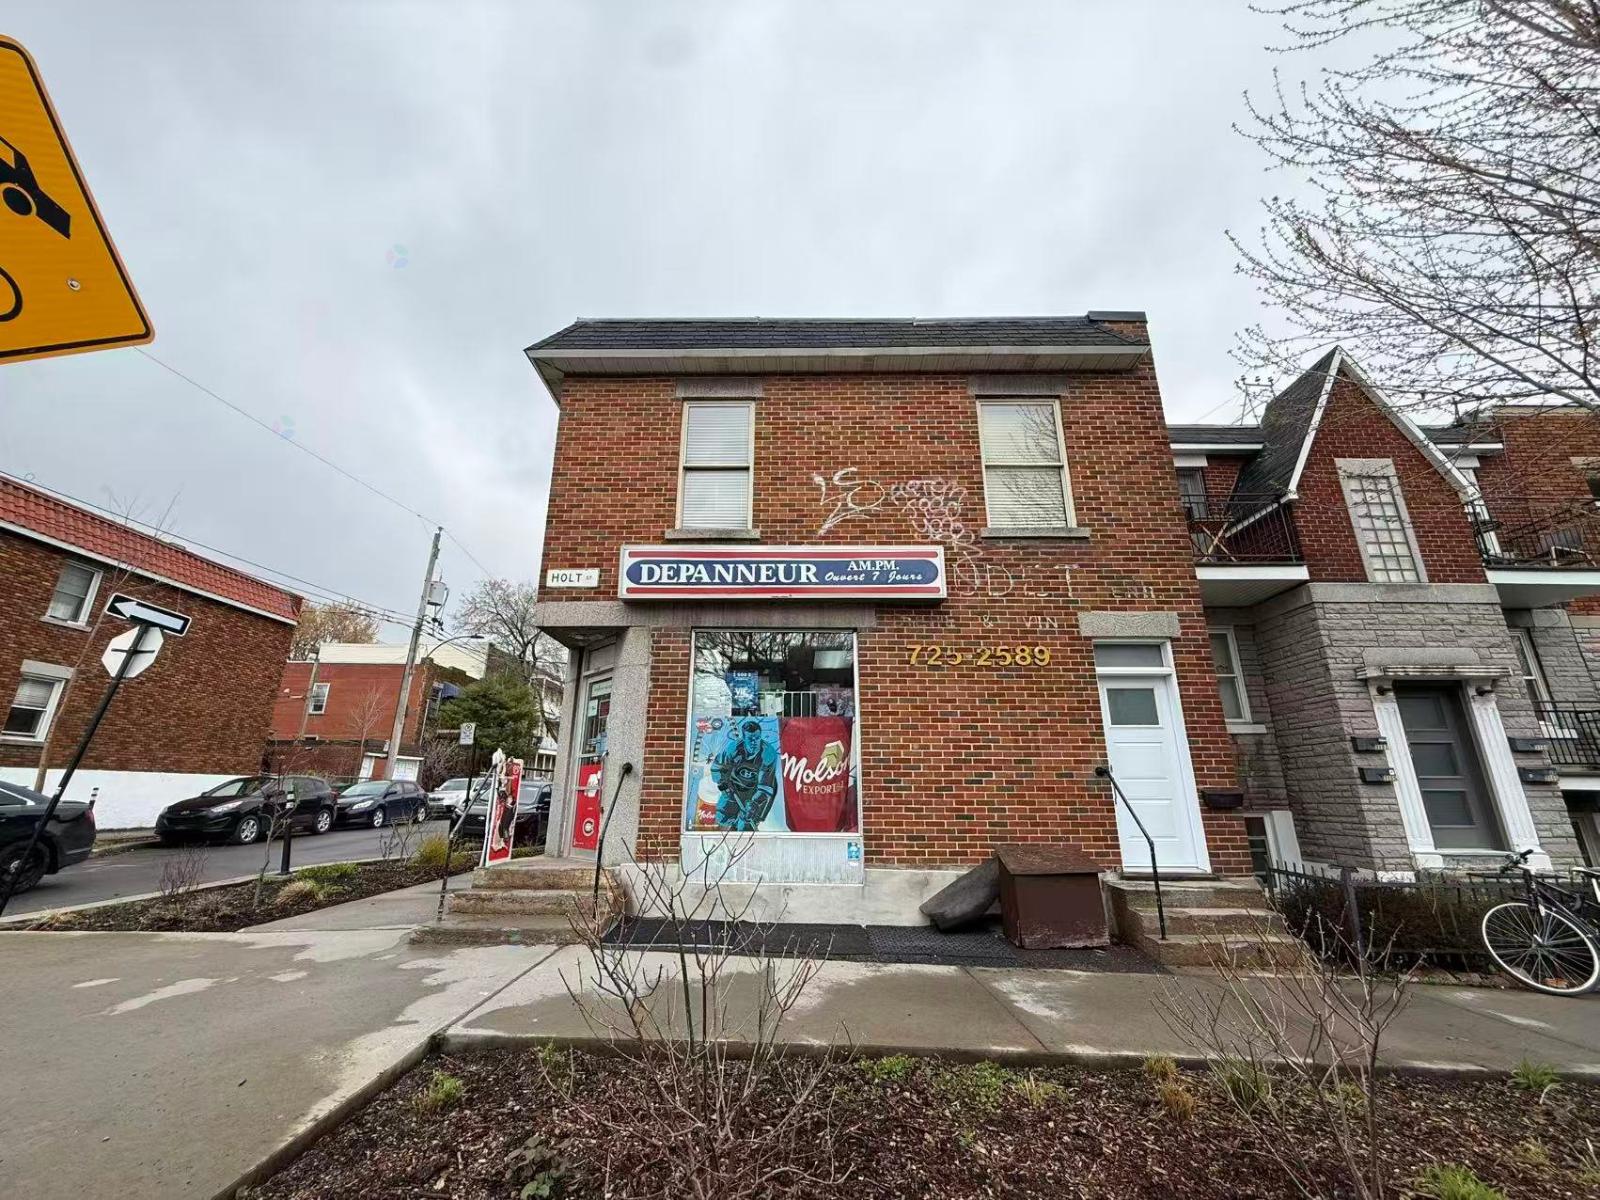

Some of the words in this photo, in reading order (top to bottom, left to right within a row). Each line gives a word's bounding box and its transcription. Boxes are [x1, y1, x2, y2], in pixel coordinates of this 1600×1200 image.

[551, 573, 583, 583] HOLT
[639, 562, 819, 584] DEPANNEUR
[824, 571, 865, 582] Ouvert
[872, 571, 880, 581] 7
[888, 570, 923, 583] Jours
[906, 644, 1051, 667] 725-2589
